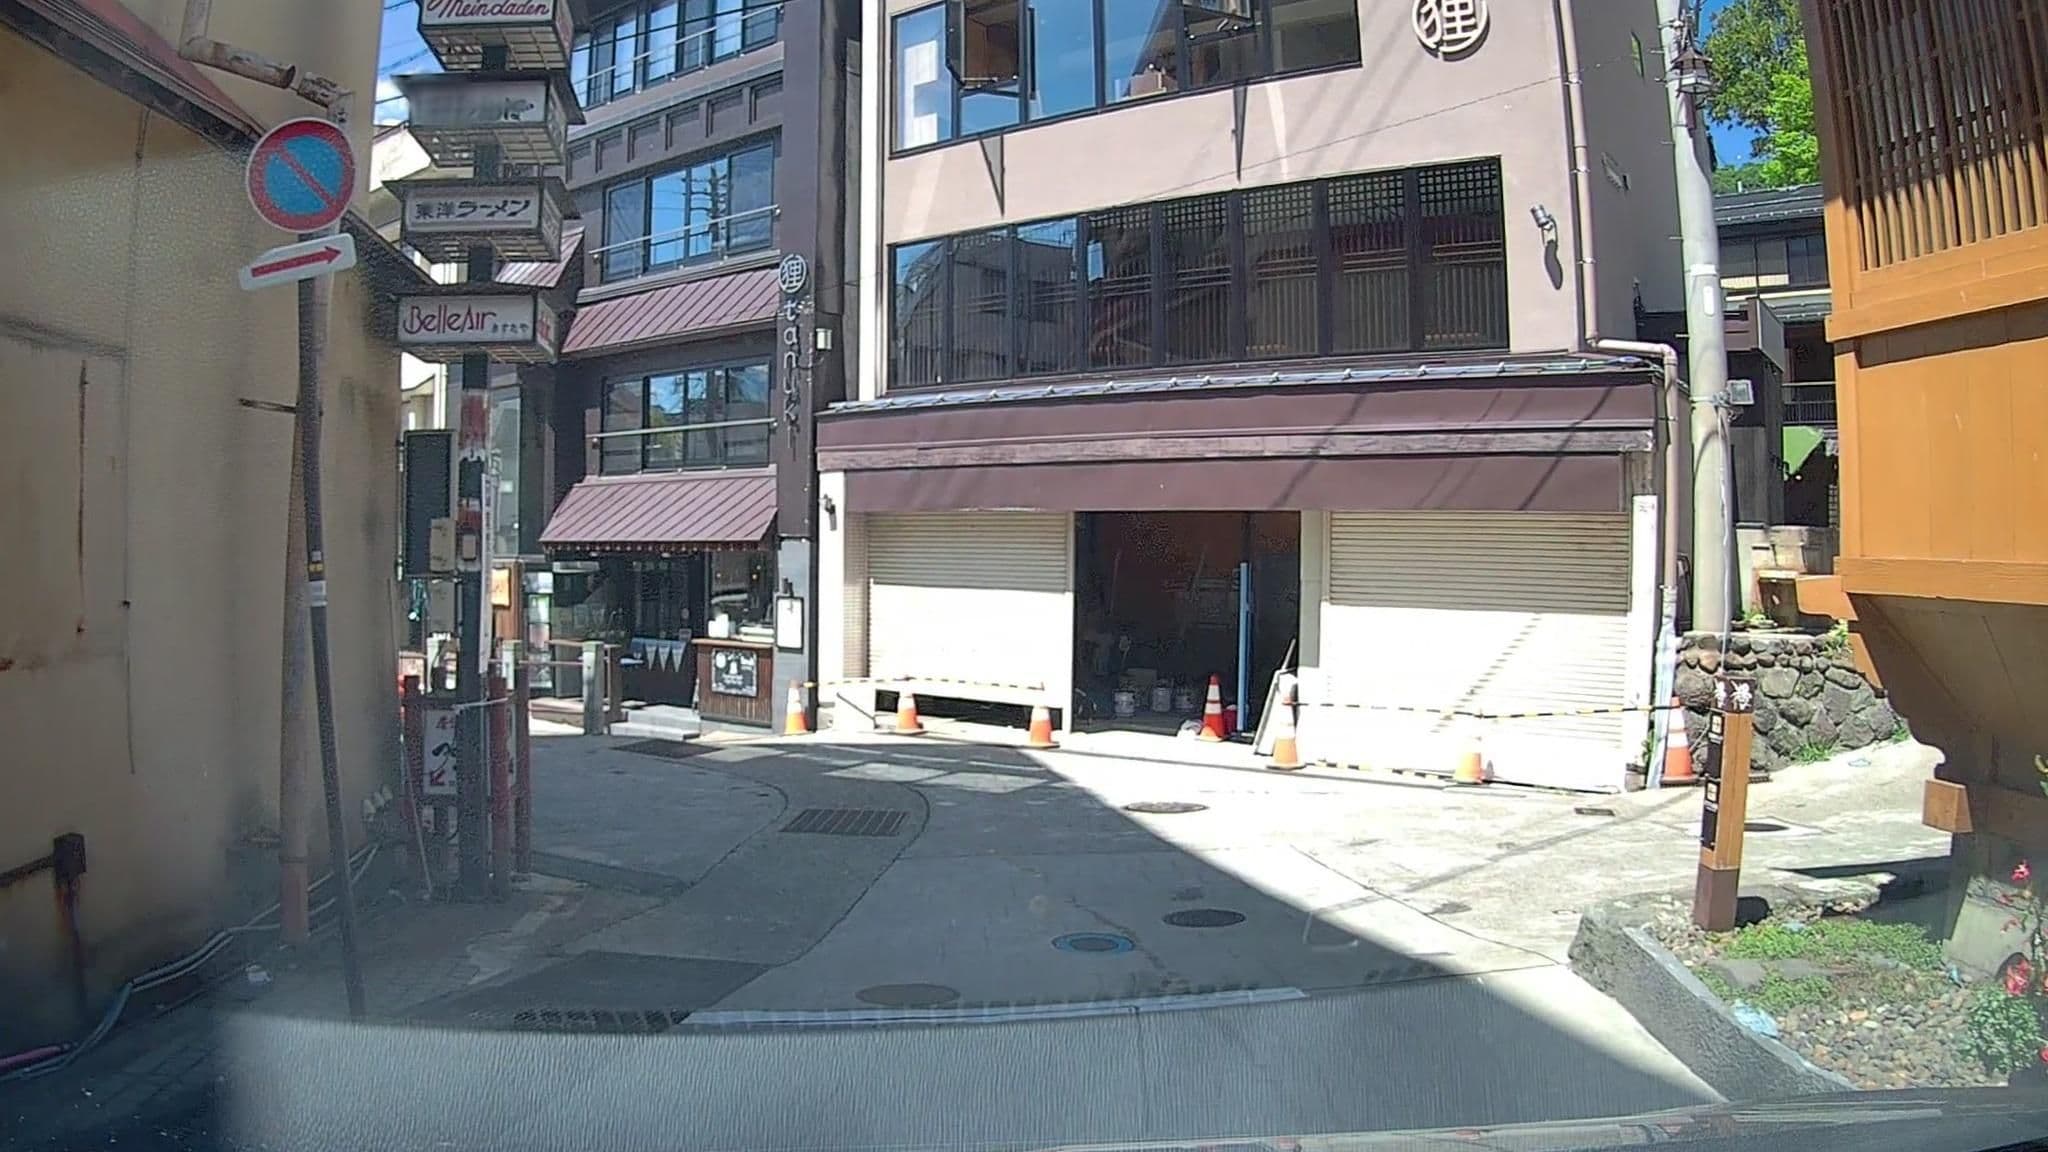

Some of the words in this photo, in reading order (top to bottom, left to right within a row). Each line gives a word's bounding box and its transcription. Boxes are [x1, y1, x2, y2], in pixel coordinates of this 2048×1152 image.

[414, 199, 531, 221] 東洋ラーメン
